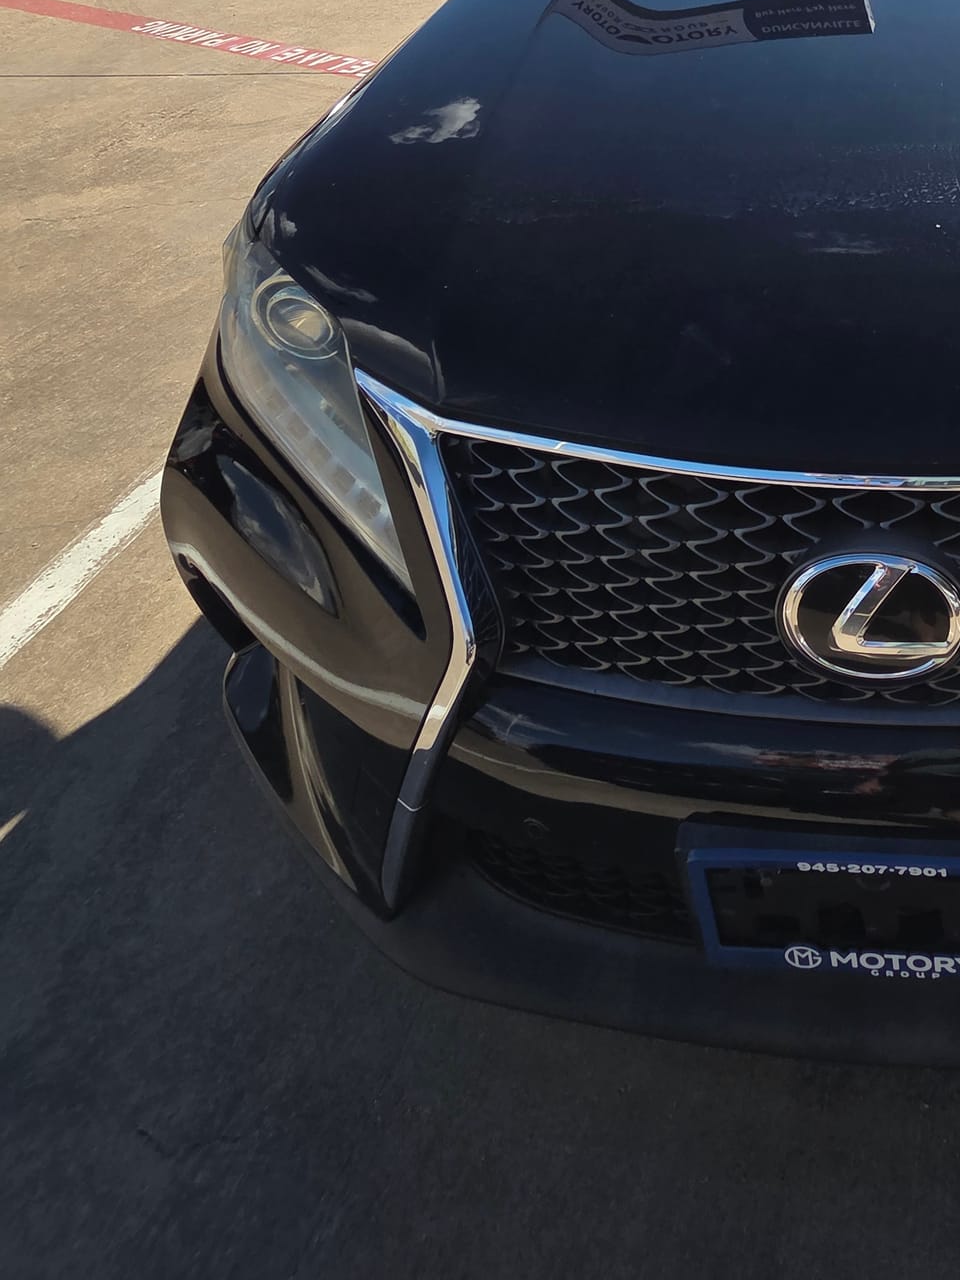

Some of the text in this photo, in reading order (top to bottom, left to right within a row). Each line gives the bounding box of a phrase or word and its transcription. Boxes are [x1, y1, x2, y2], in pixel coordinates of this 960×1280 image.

[131, 20, 240, 48] PARKING
[229, 40, 281, 56] NO
[797, 862, 948, 878] 945-207-7901
[870, 969, 941, 980] GROUP
